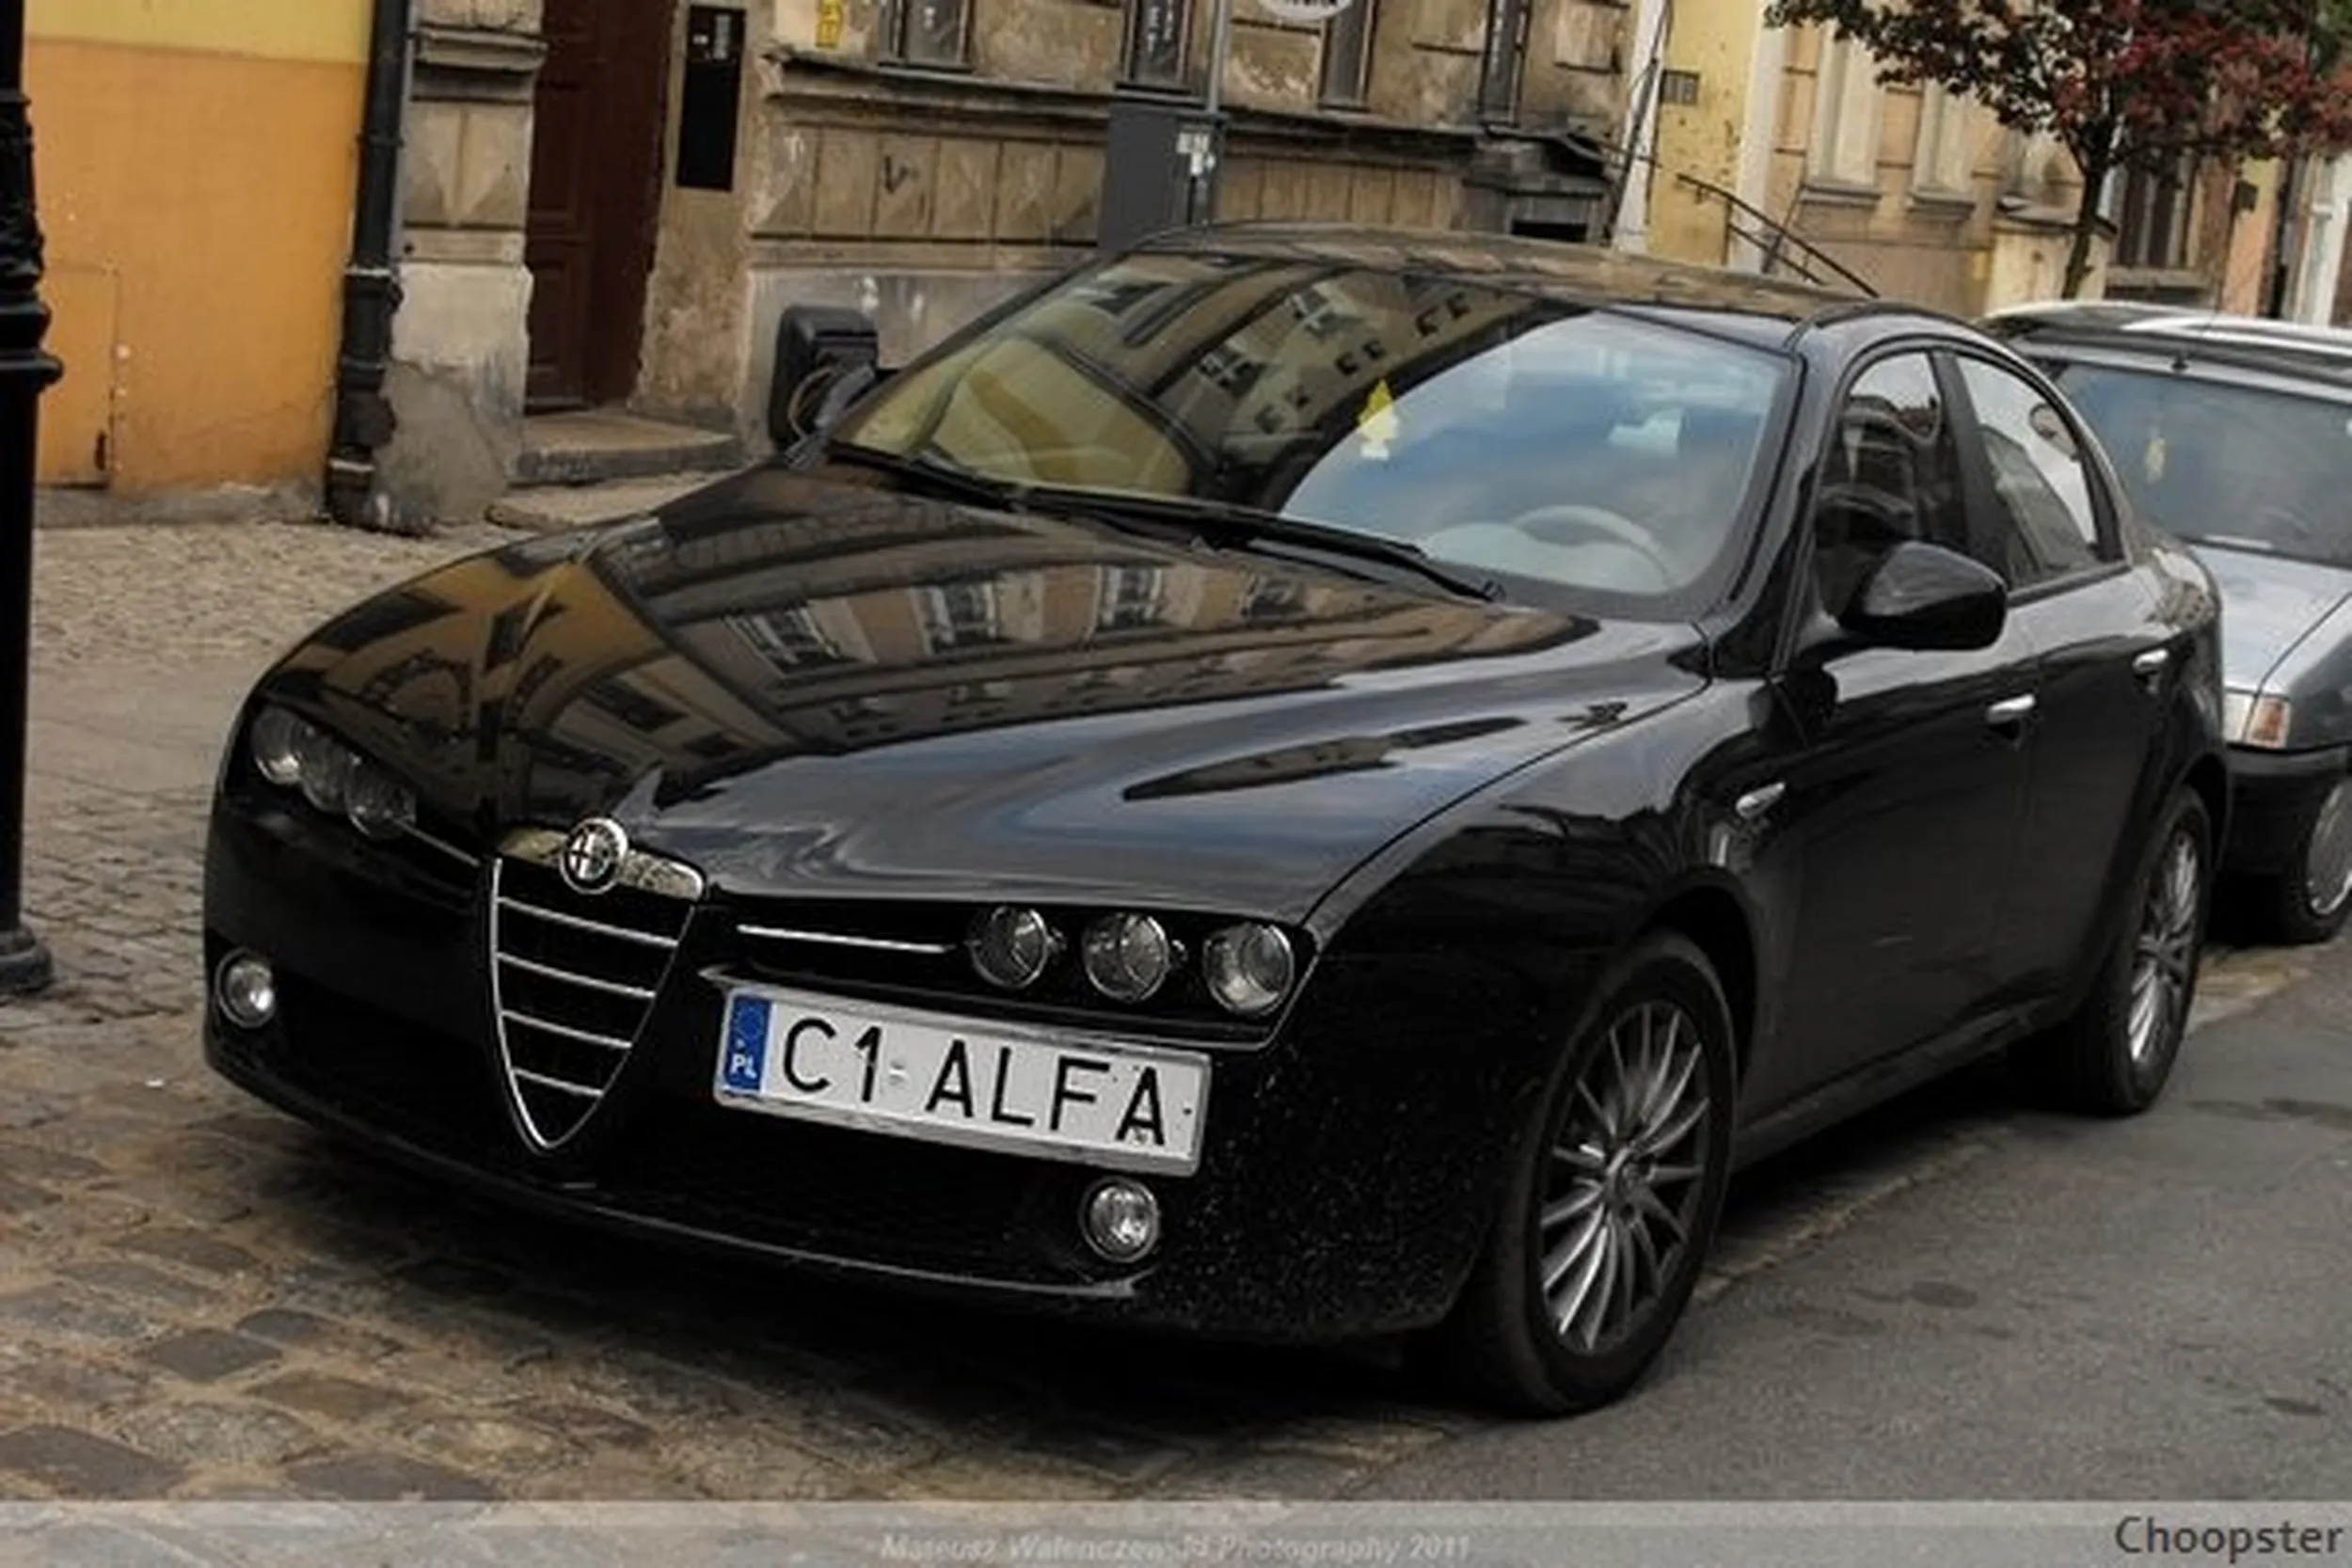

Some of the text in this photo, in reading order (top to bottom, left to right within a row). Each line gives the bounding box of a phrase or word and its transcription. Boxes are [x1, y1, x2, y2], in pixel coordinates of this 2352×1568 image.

[729, 1053, 757, 1080] PL
[782, 1018, 1167, 1147] C1 ALFA
